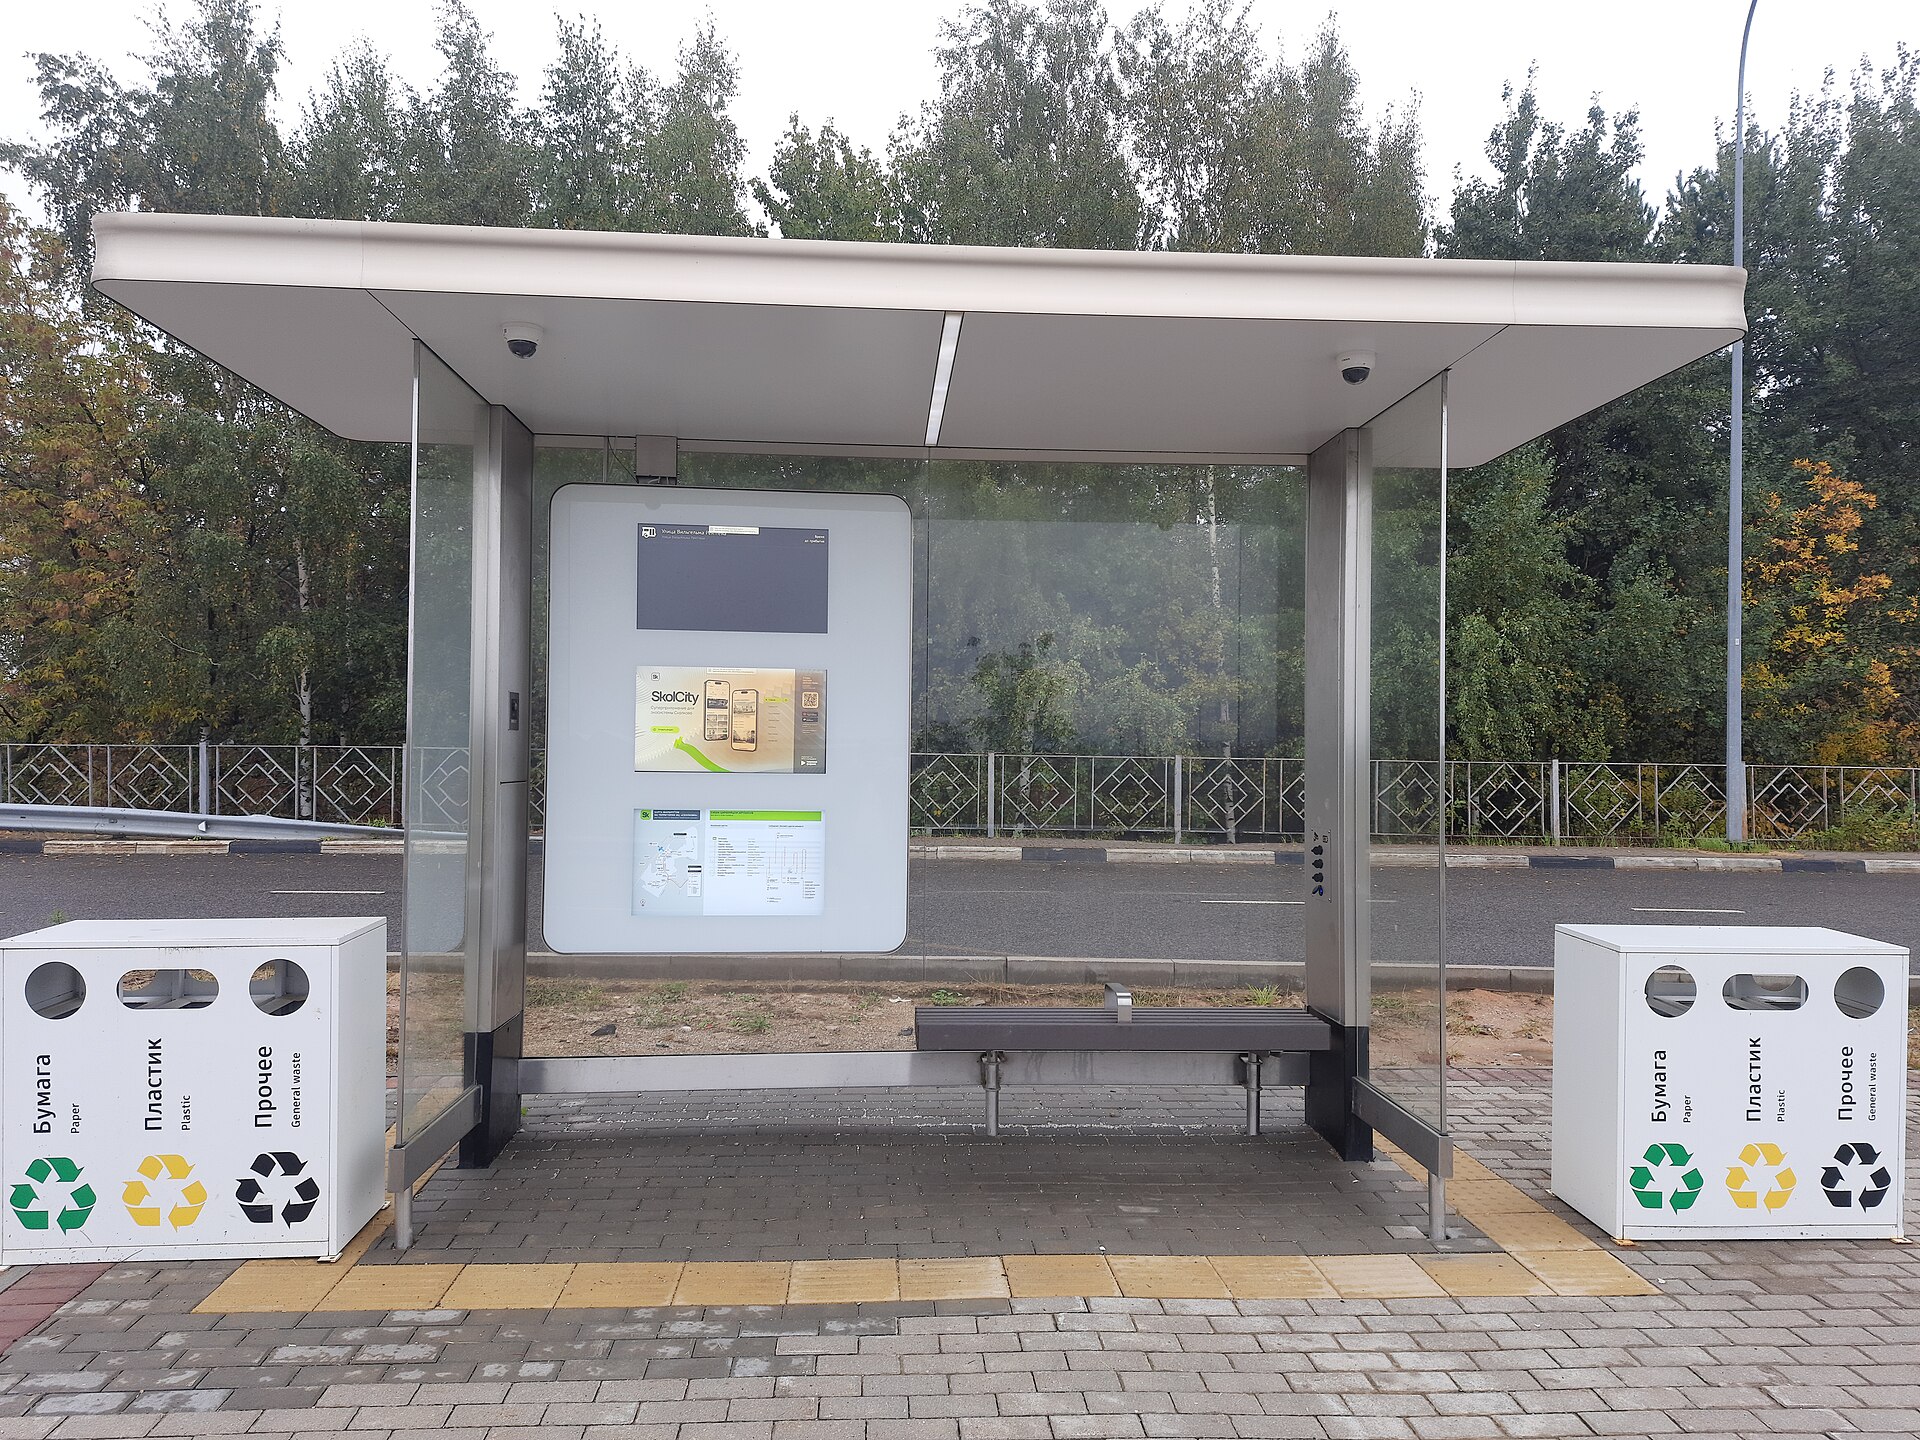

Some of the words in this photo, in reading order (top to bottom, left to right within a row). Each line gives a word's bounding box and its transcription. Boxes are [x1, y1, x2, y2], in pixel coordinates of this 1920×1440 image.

[651, 691, 700, 706] SkolCity
[144, 1037, 163, 1131] Пластик
[291, 1052, 301, 1084] waste
[1746, 1037, 1762, 1122] Пластик
[1837, 1046, 1857, 1121] Прочее
[1869, 1052, 1877, 1081] waste
[32, 1054, 57, 1134] Бумага
[254, 1046, 277, 1128] Прочее
[1650, 1050, 1671, 1122] Бумага
[1867, 1083, 1877, 1121] General
[70, 1102, 82, 1134] Paper
[180, 1095, 191, 1131] Plastic
[290, 1086, 301, 1128] General
[1682, 1094, 1693, 1123] Paper
[1776, 1089, 1786, 1122] Plastic
